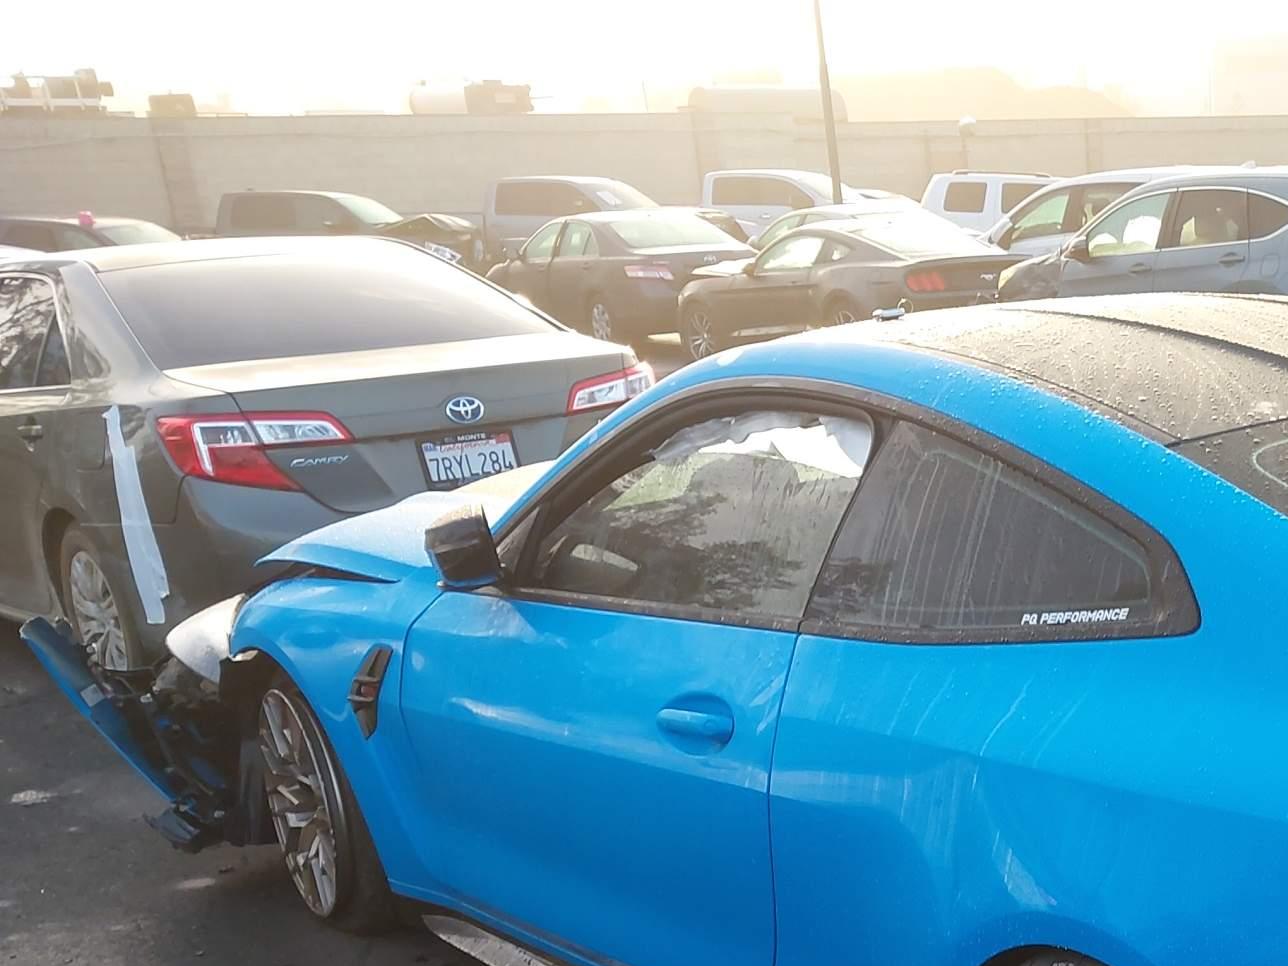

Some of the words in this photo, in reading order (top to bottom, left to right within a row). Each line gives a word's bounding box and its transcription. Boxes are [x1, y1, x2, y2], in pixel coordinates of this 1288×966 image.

[457, 432, 486, 442] MONTE
[429, 449, 514, 482] 7RYL284
[1021, 614, 1038, 626] PQ
[1040, 608, 1129, 625] PERFORMANCE
